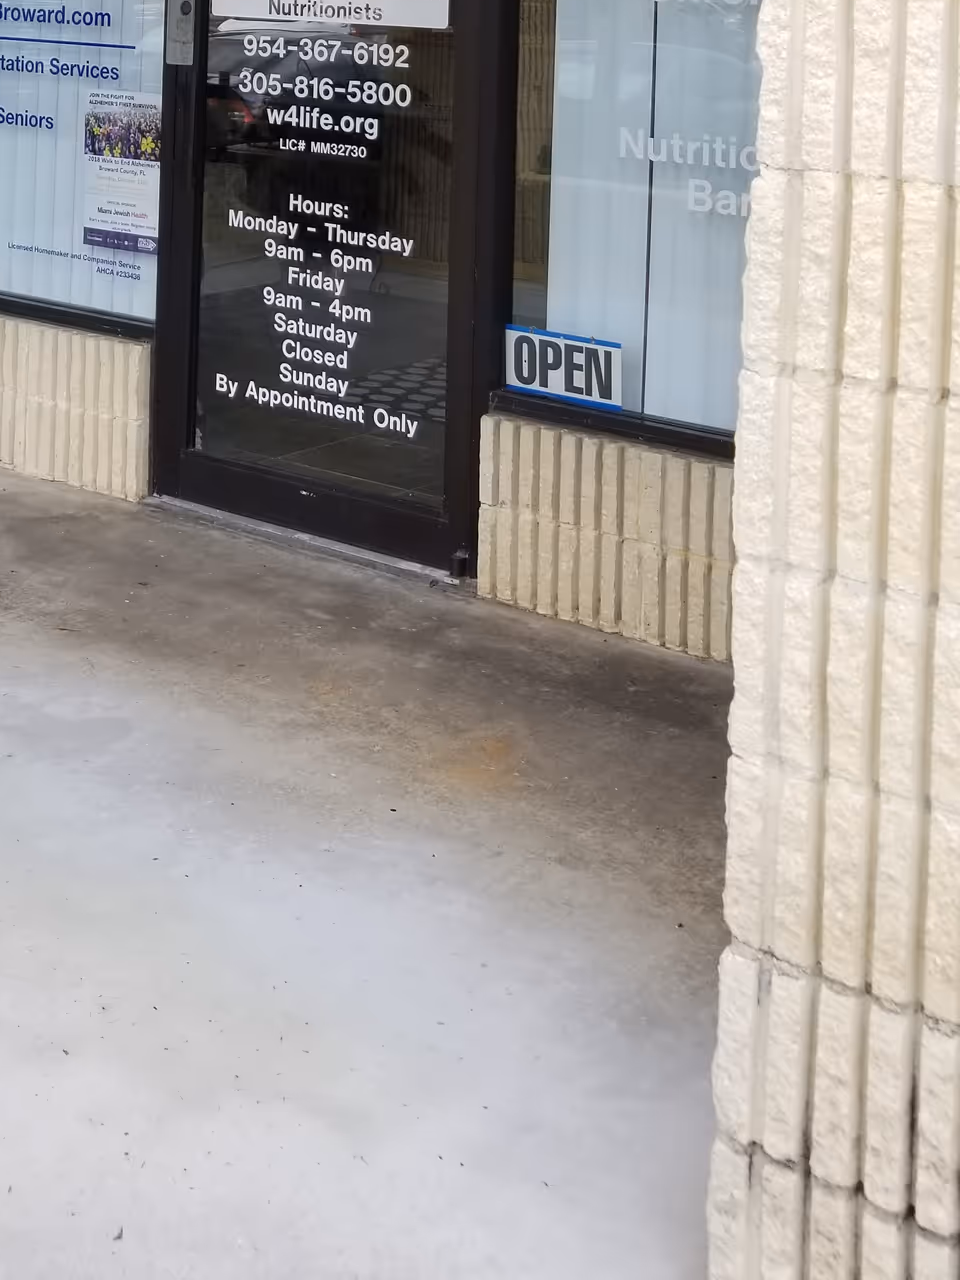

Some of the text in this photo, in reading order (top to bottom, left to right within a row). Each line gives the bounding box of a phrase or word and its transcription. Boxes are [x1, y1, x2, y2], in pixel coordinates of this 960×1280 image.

[243, 35, 409, 68] 954-367-6192
[49, 58, 120, 81] Services
[238, 72, 412, 107] 305-816-5800
[267, 104, 380, 140] w4life.org
[279, 137, 367, 159] LIC# MM32730
[99, 165, 119, 173] Broward
[289, 193, 350, 219] Hours:
[228, 209, 299, 240] Monday
[324, 222, 414, 257] Thursday
[7, 242, 141, 271] Licensed Homemaker and Companion Service
[96, 266, 115, 277] AHCA
[263, 239, 305, 262] 9am
[330, 249, 373, 273] 6pm
[287, 266, 345, 296] Friday
[263, 287, 302, 312] 9am
[328, 299, 371, 324] 4pm
[273, 313, 358, 348] Saturday
[282, 339, 349, 369] Closed
[513, 334, 612, 401] OPEN
[279, 363, 349, 398] Sunday
[215, 374, 418, 438] By Appointment Only
